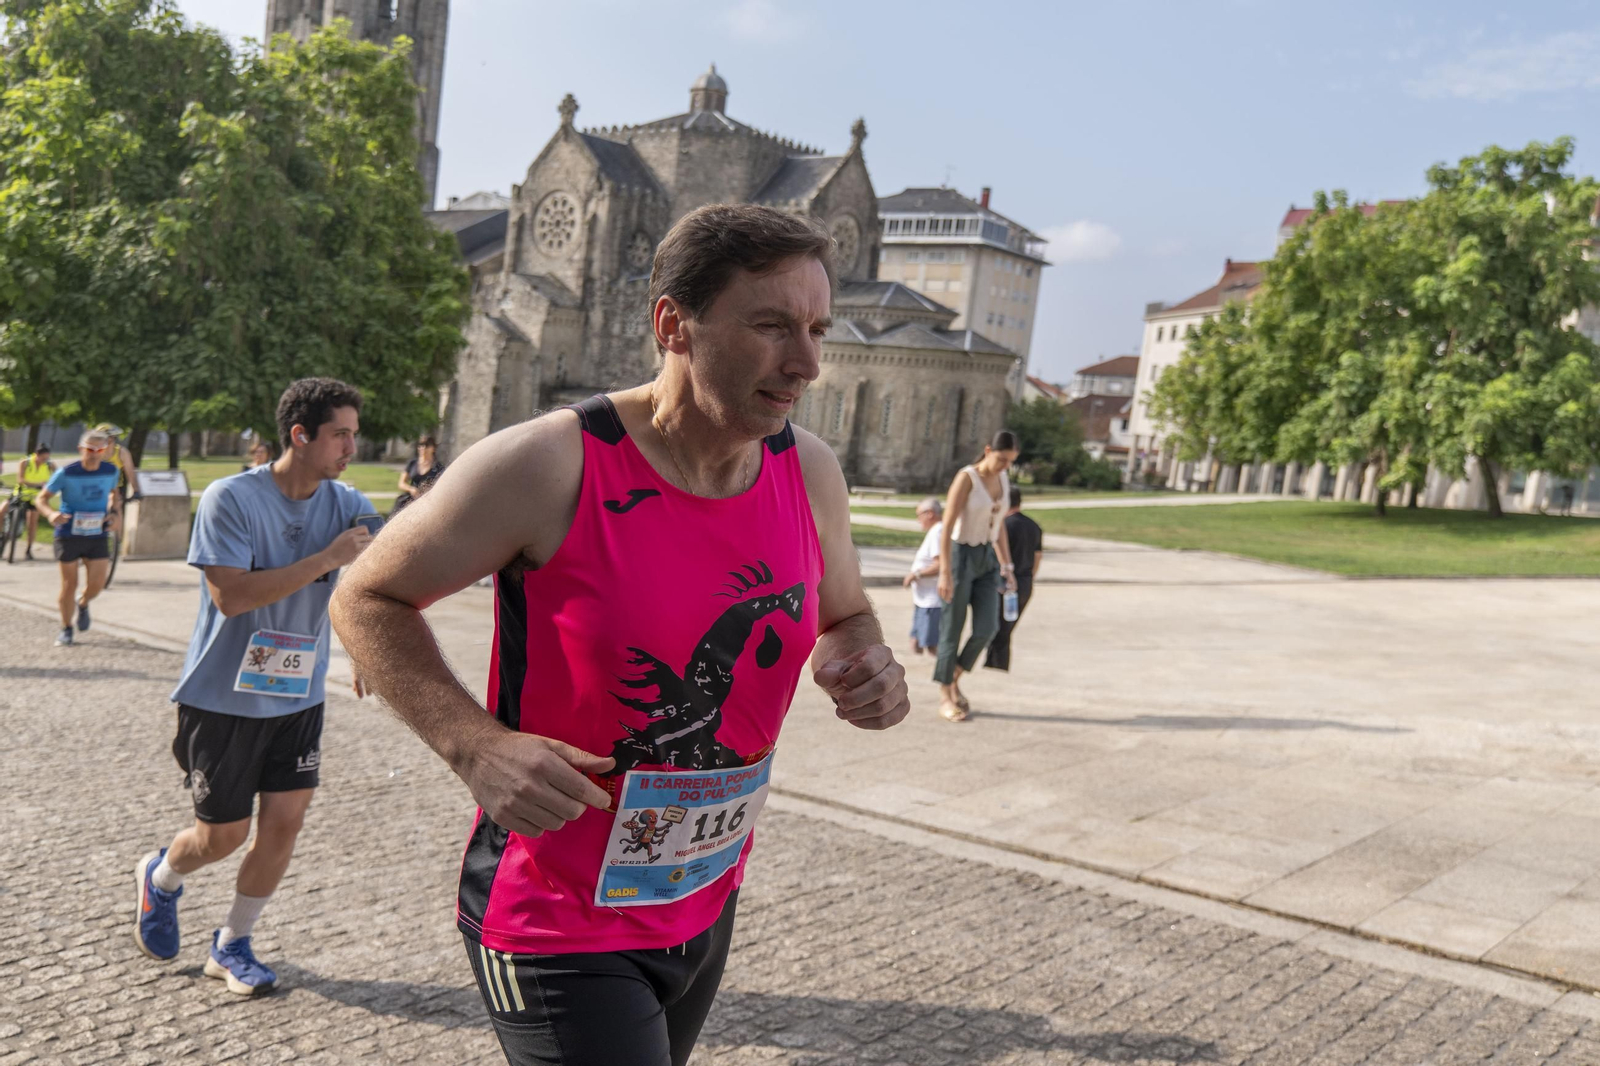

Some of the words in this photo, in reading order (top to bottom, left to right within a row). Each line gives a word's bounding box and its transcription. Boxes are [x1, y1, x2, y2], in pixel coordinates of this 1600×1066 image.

[283, 654, 301, 669] 65
[640, 778, 650, 790] II
[653, 776, 722, 790] CARREIRA
[678, 790, 700, 802] DO
[703, 784, 742, 800] PULPO
[690, 801, 748, 844] 116
[674, 846, 697, 858] MIGUEL
[697, 842, 716, 852] ANGEL
[606, 887, 639, 898] GADIS
